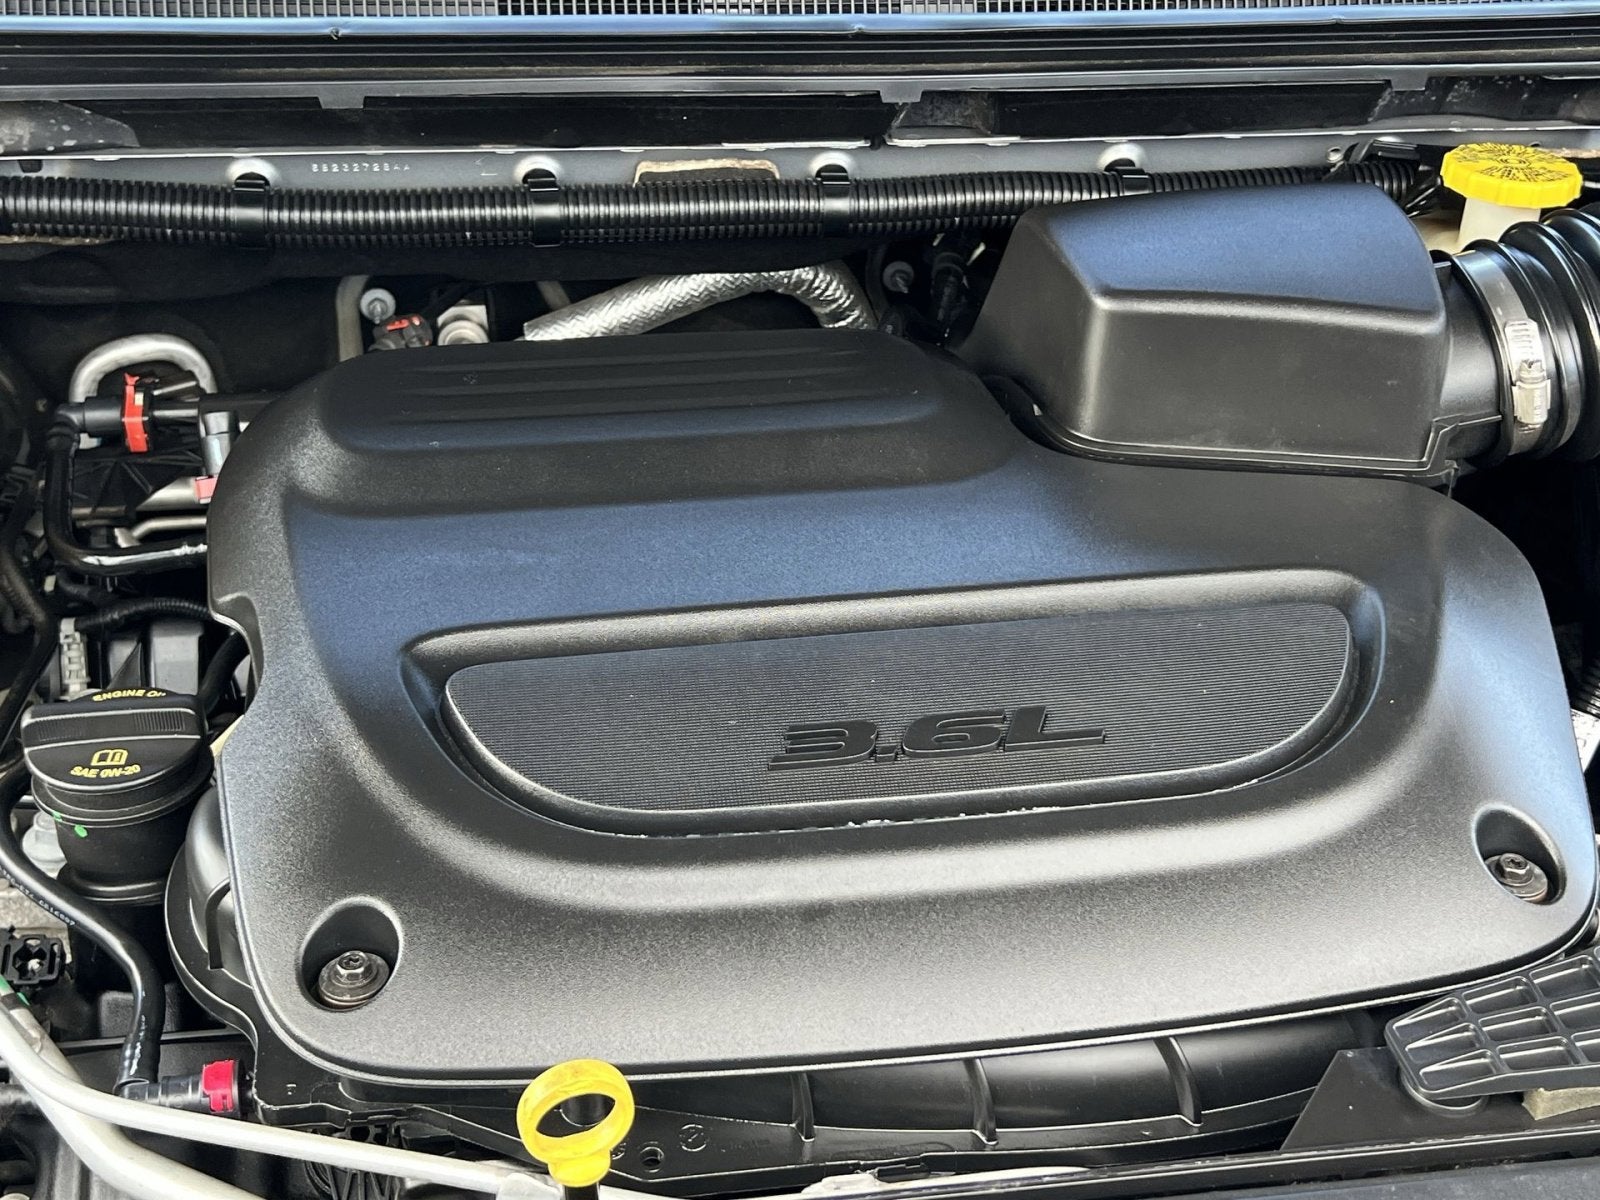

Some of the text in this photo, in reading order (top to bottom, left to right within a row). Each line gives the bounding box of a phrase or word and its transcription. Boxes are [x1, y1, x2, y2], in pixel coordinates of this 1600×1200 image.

[92, 689, 146, 701] ENGINE
[767, 704, 1106, 771] 3.6L
[70, 764, 141, 778] SAE 0W-20
